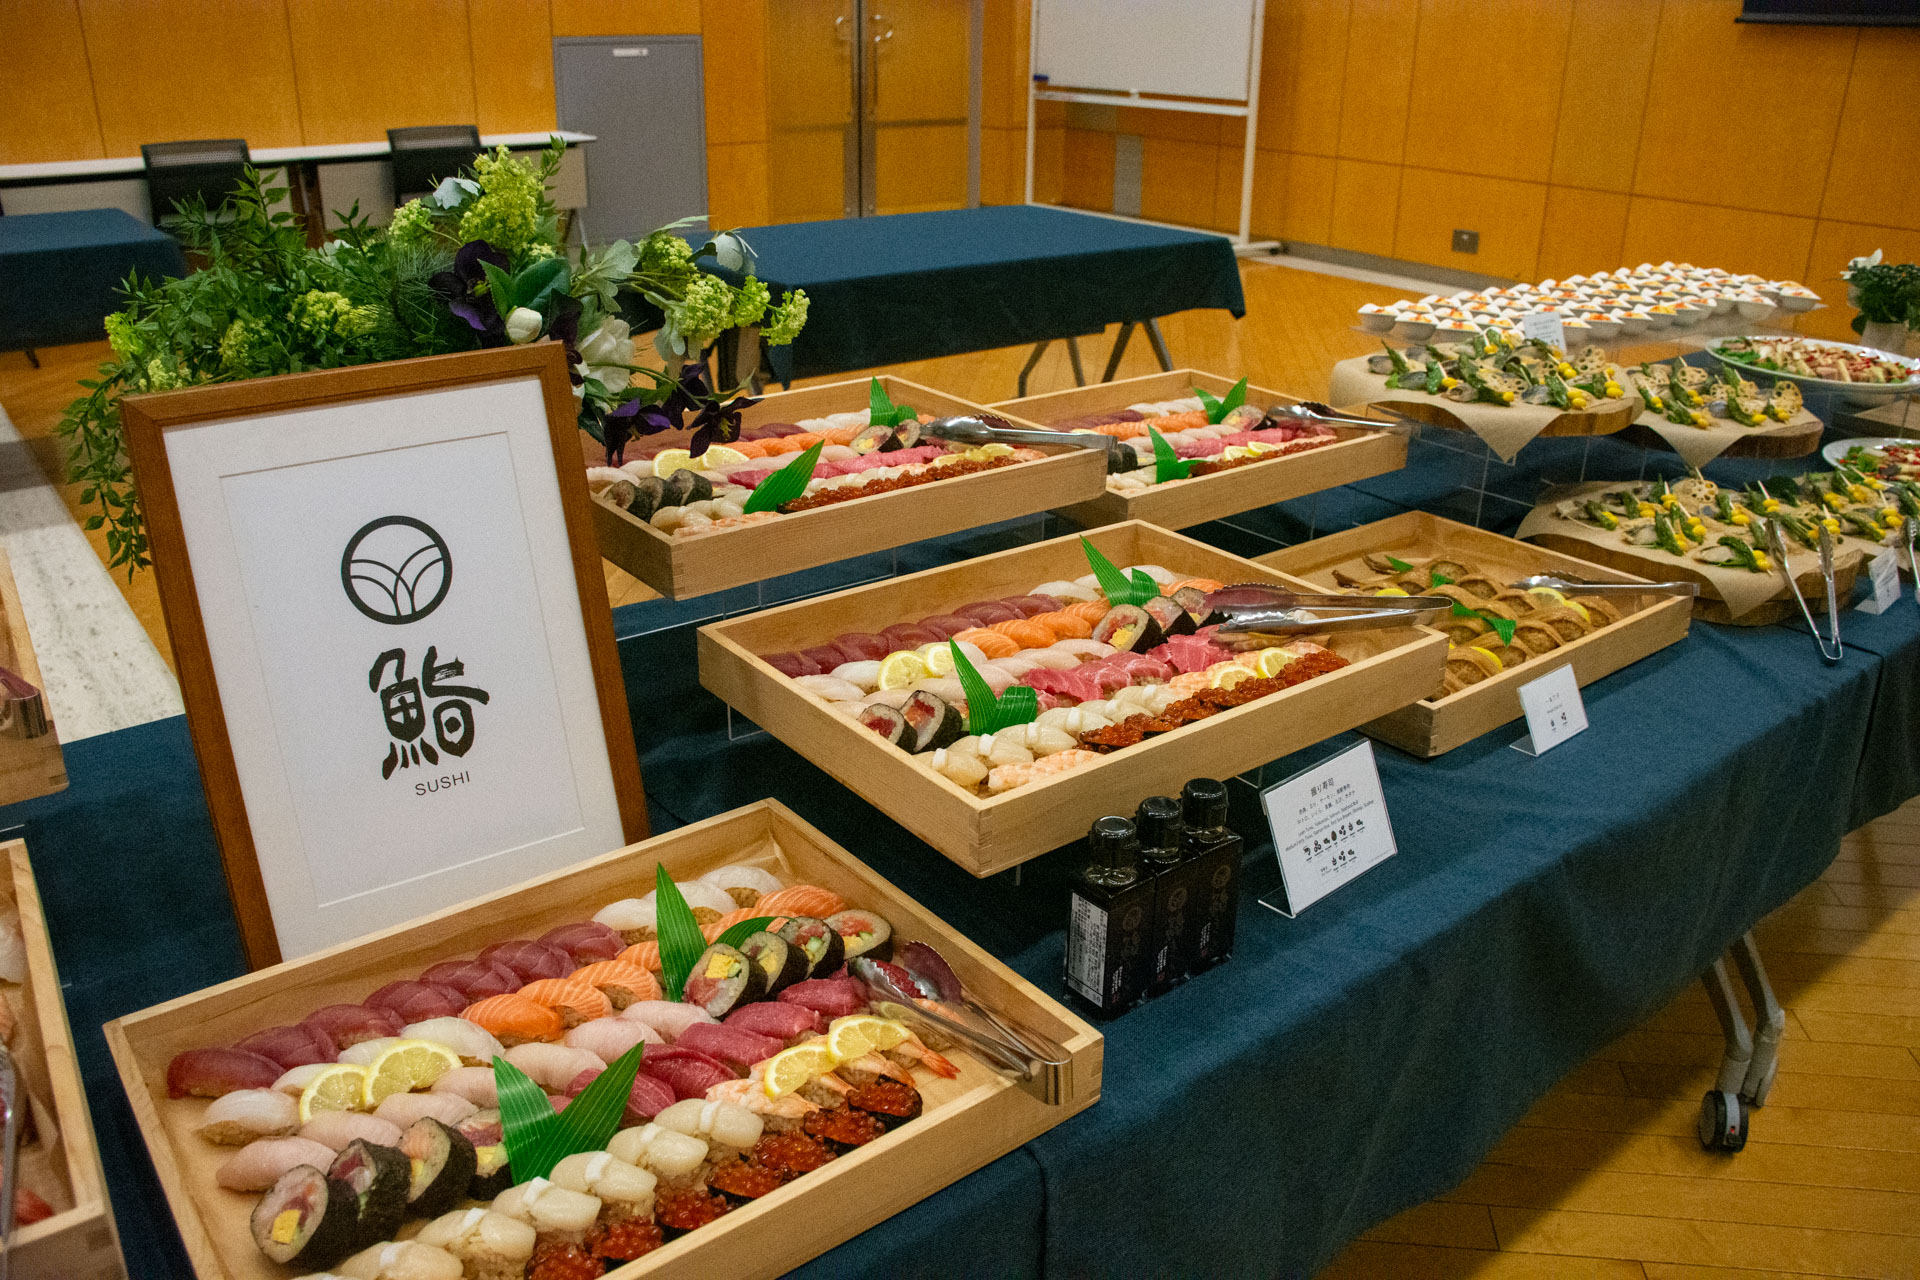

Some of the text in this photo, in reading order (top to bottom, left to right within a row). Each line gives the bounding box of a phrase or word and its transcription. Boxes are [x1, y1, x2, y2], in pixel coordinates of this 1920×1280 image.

[415, 770, 471, 796] SUSHI
[1310, 777, 1334, 797] 握り寿司
